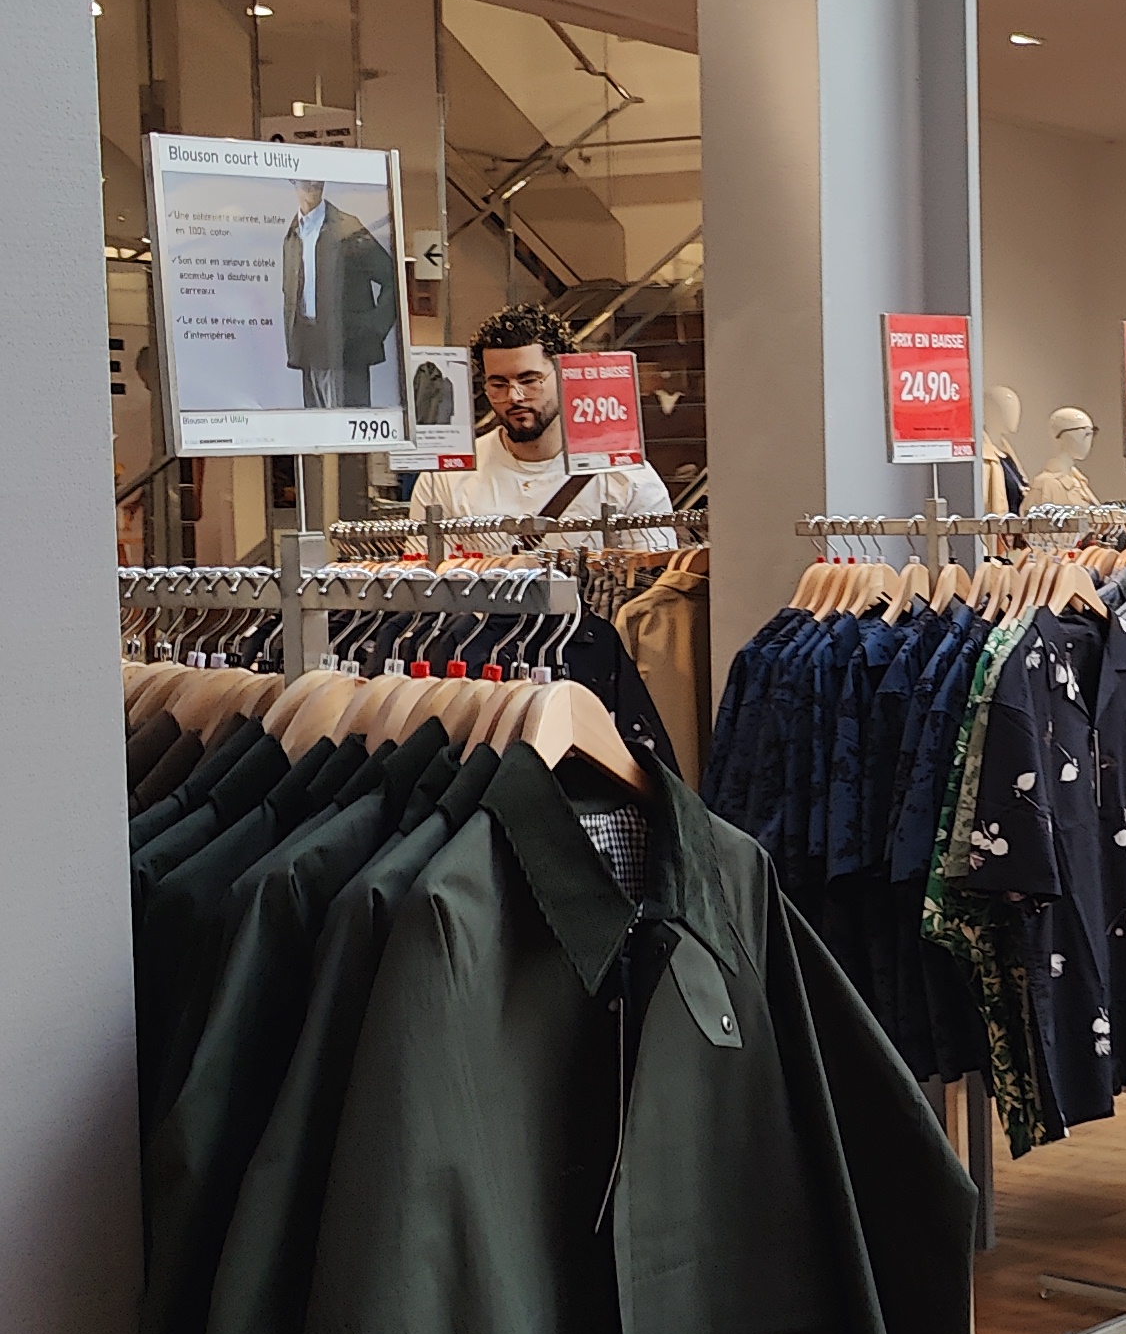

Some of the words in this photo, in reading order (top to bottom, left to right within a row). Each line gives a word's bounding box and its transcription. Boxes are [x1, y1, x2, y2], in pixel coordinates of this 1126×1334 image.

[168, 145, 219, 164] Blouson
[224, 151, 259, 166] court
[264, 152, 300, 172] Utility
[182, 316, 192, 324] Le
[195, 316, 207, 325] col
[210, 317, 219, 325] se
[248, 317, 258, 326] en
[260, 317, 273, 326] cas
[890, 332, 913, 348] PRIX
[915, 333, 929, 348] EN
[931, 334, 965, 349] BAISSE
[562, 367, 584, 380] PRIX
[584, 367, 599, 380] EN
[599, 366, 631, 379] BAISSE
[900, 371, 960, 404] 24,90€
[572, 396, 628, 424] 29,90€
[182, 416, 208, 425] Blouson
[211, 415, 228, 424] court
